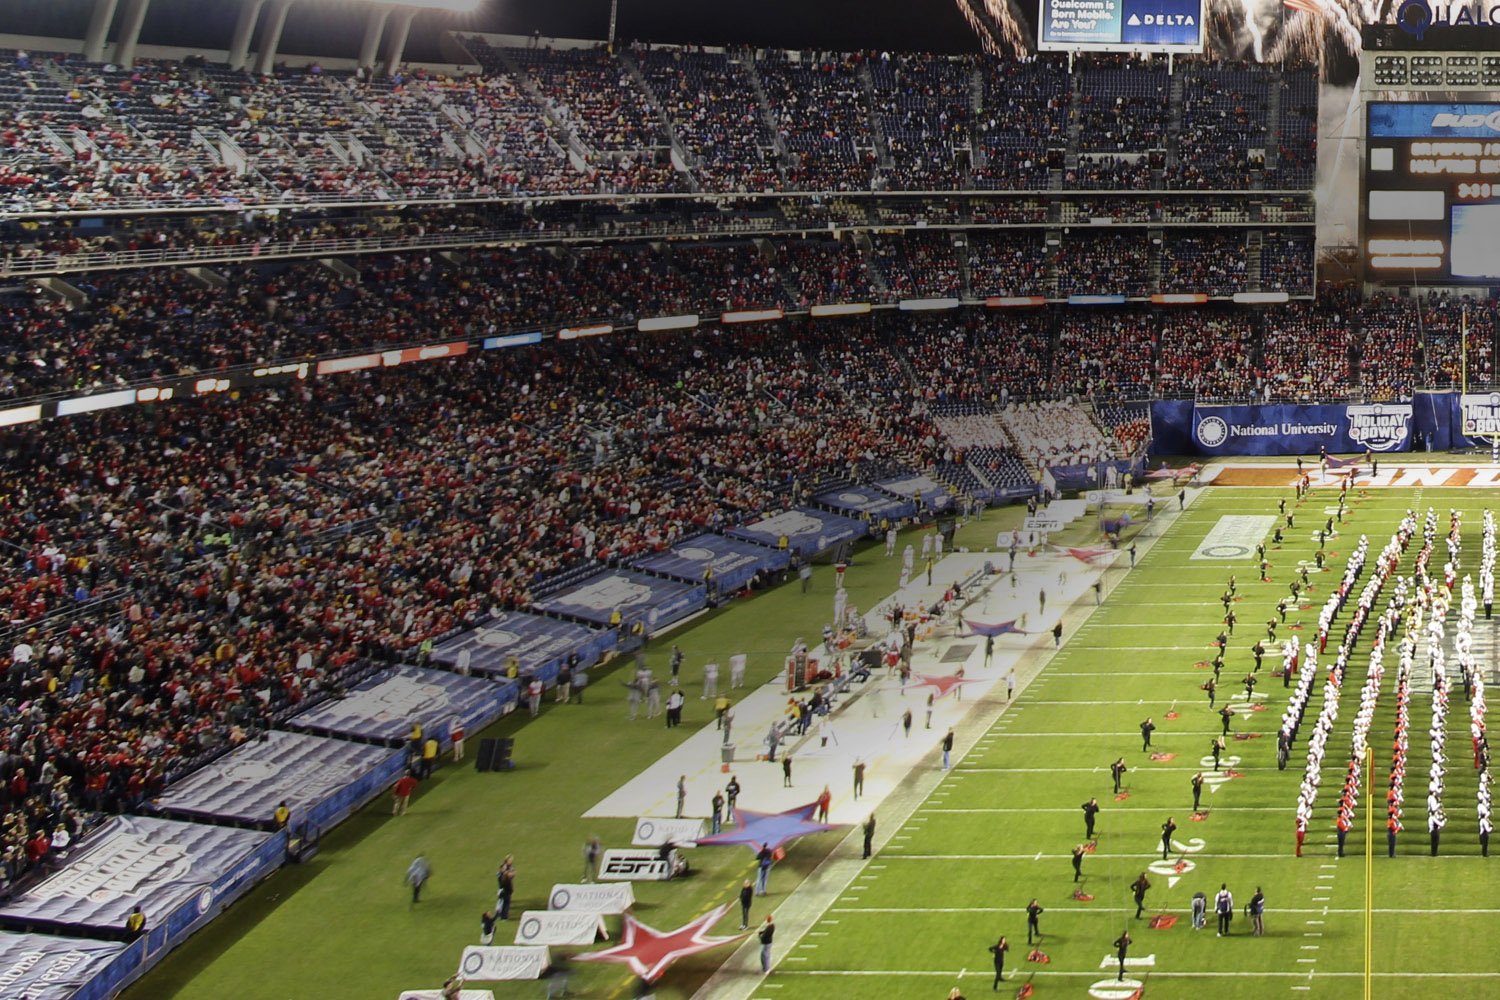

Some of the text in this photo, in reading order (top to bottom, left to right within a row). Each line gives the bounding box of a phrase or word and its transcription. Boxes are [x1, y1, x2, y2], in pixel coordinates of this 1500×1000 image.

[1105, 0, 1115, 10] is
[1051, 9, 1114, 20] Born Mobile.
[1144, 14, 1195, 26] DELTA
[1050, 19, 1097, 29] Are You?
[1431, 113, 1486, 128] BUD
[1353, 413, 1405, 428] HOLIDAY
[1230, 424, 1279, 437] National
[1281, 421, 1338, 437] University
[1360, 426, 1399, 440] BOWL
[1290, 467, 1456, 487] SAN
[606, 857, 668, 873] ESPN
[0, 951, 47, 993] ional
